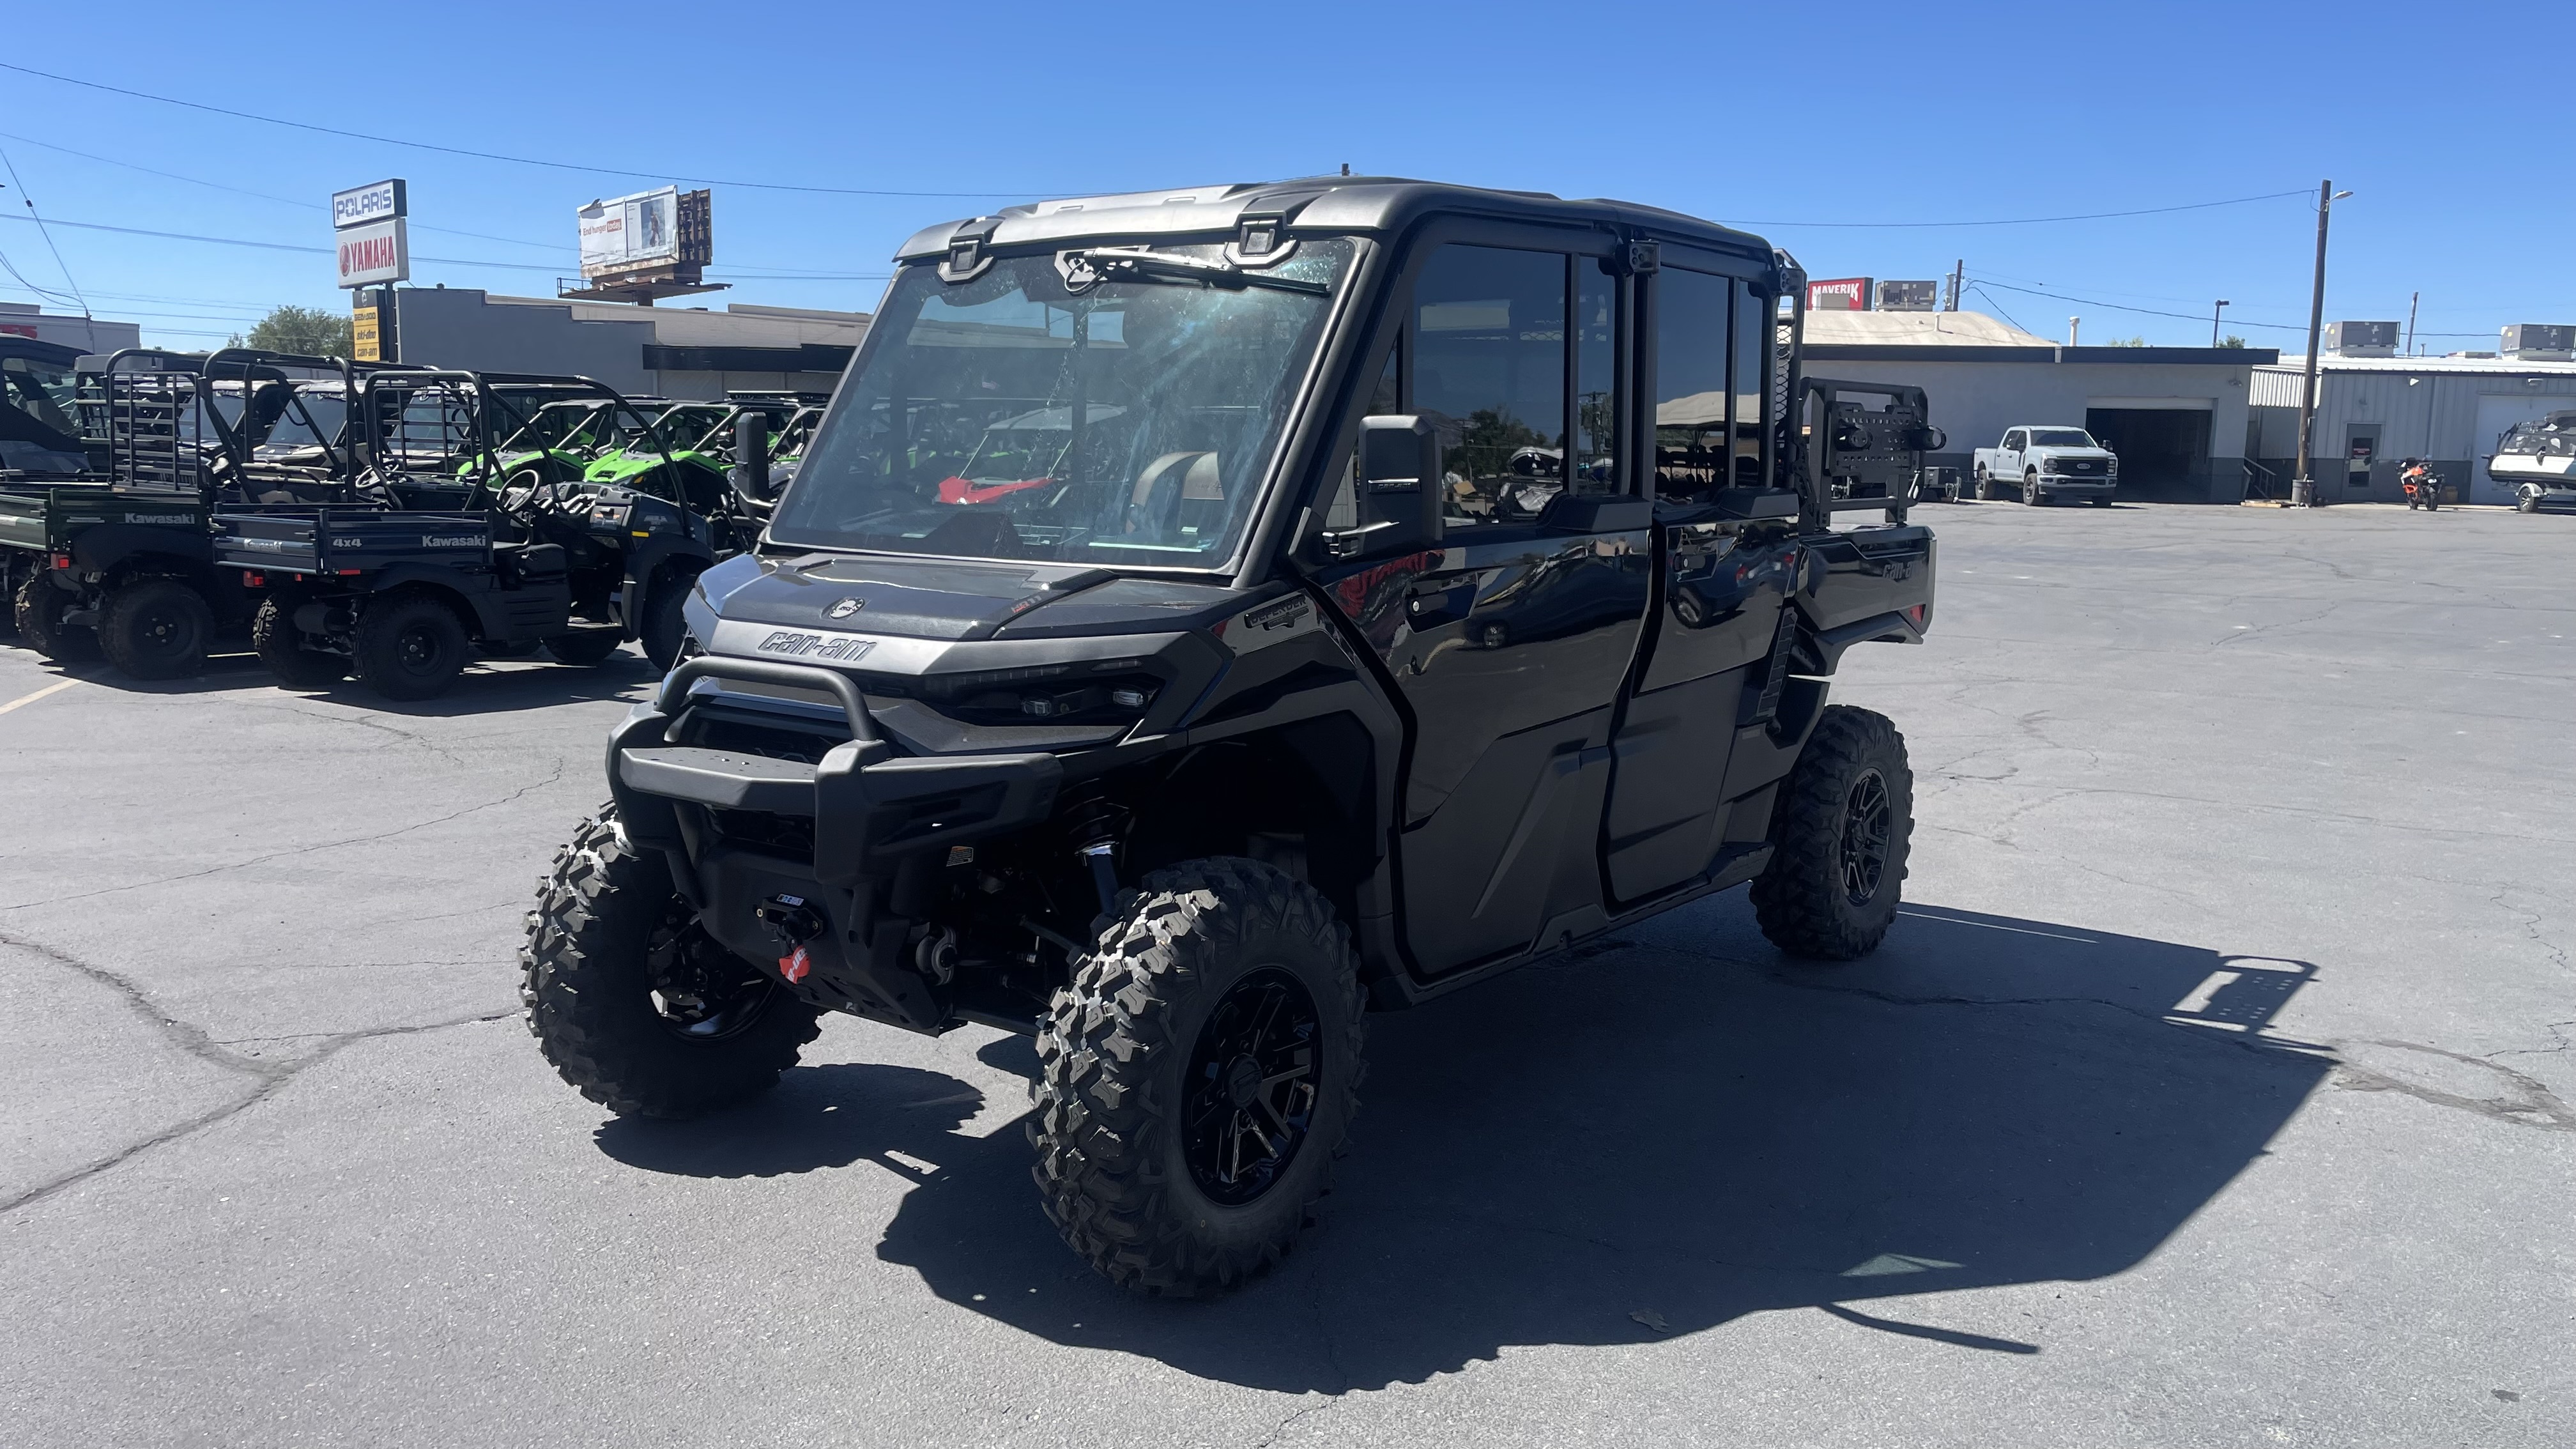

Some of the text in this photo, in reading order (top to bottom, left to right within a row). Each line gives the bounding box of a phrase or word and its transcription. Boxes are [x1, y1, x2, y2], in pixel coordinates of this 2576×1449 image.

[336, 189, 392, 220] POLARIS
[583, 226, 592, 236] End
[592, 224, 607, 234] hunger
[351, 236, 395, 272] YAMAHA
[1812, 283, 1859, 303] MAVERIK
[125, 513, 195, 524] Kawasaki
[244, 539, 282, 553] Kawasaki
[333, 539, 362, 547] 4x4
[422, 535, 486, 547] Kawasaki
[1245, 595, 1307, 627] DEFENDER
[757, 631, 878, 662] can-am
